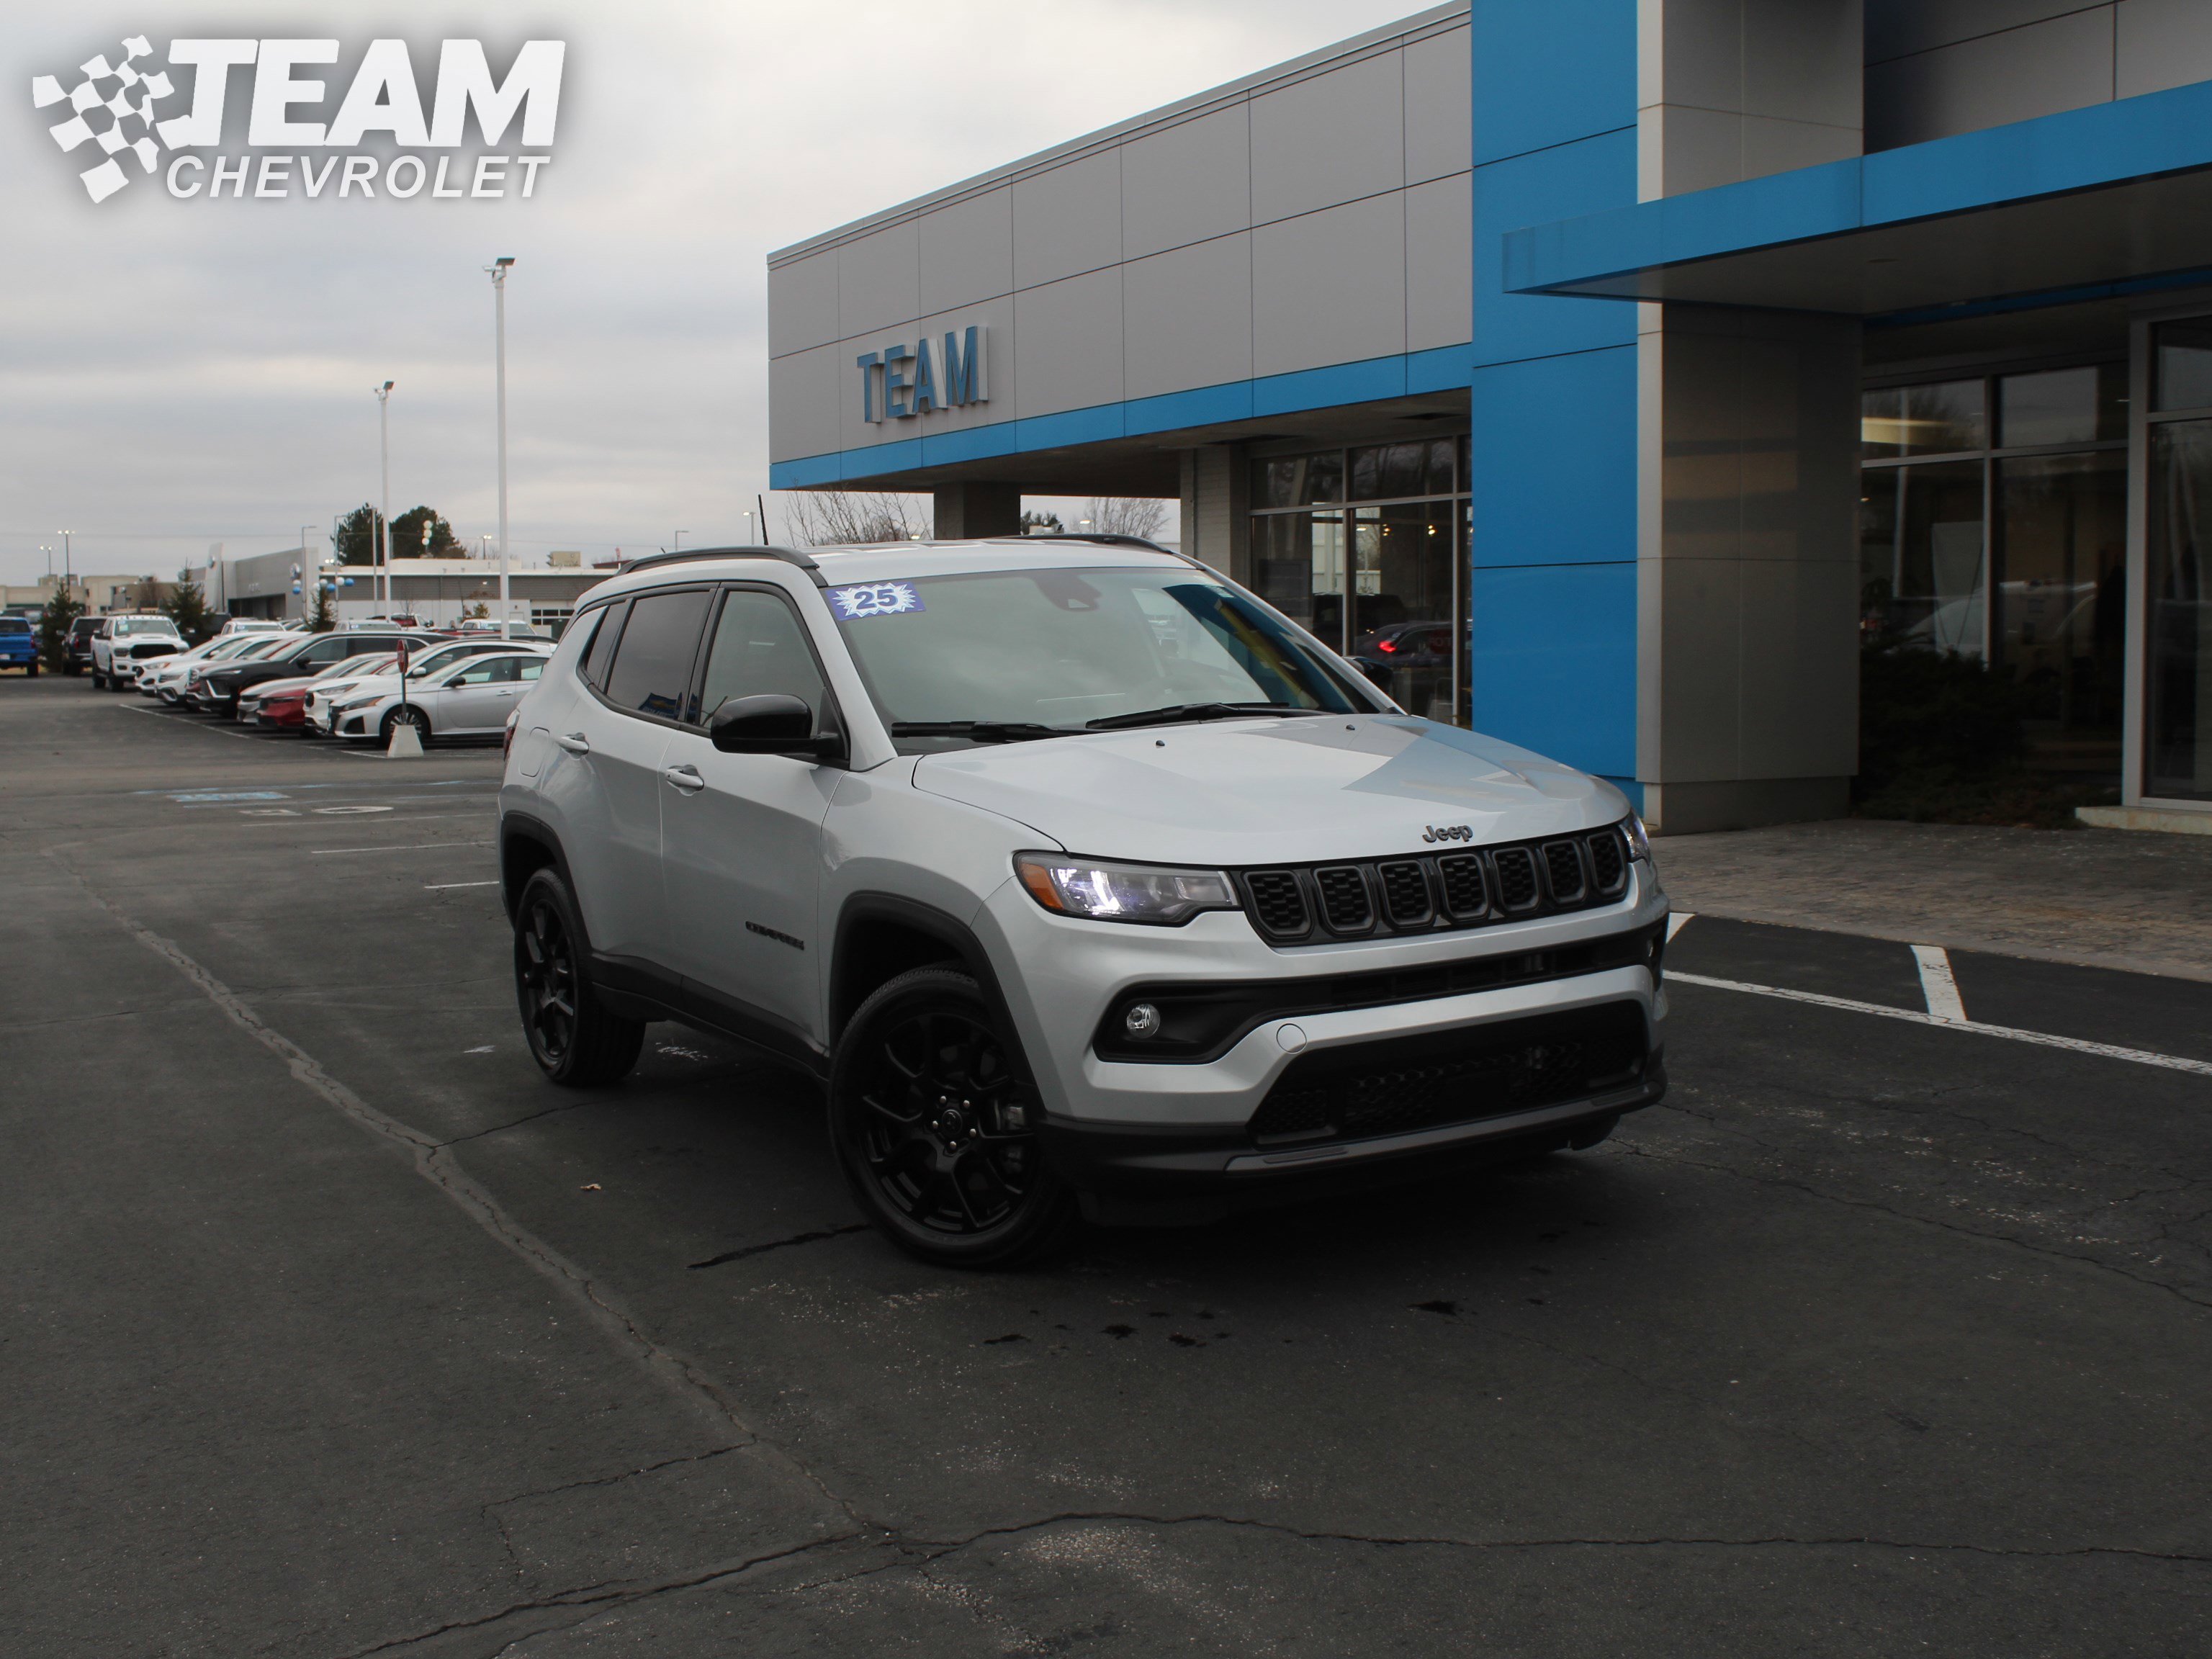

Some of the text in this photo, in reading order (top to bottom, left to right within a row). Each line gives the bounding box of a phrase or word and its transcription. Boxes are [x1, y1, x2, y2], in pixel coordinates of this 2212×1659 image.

[857, 325, 988, 423] TEAM
[853, 588, 899, 610] 25
[1422, 825, 1473, 843] Jeep
